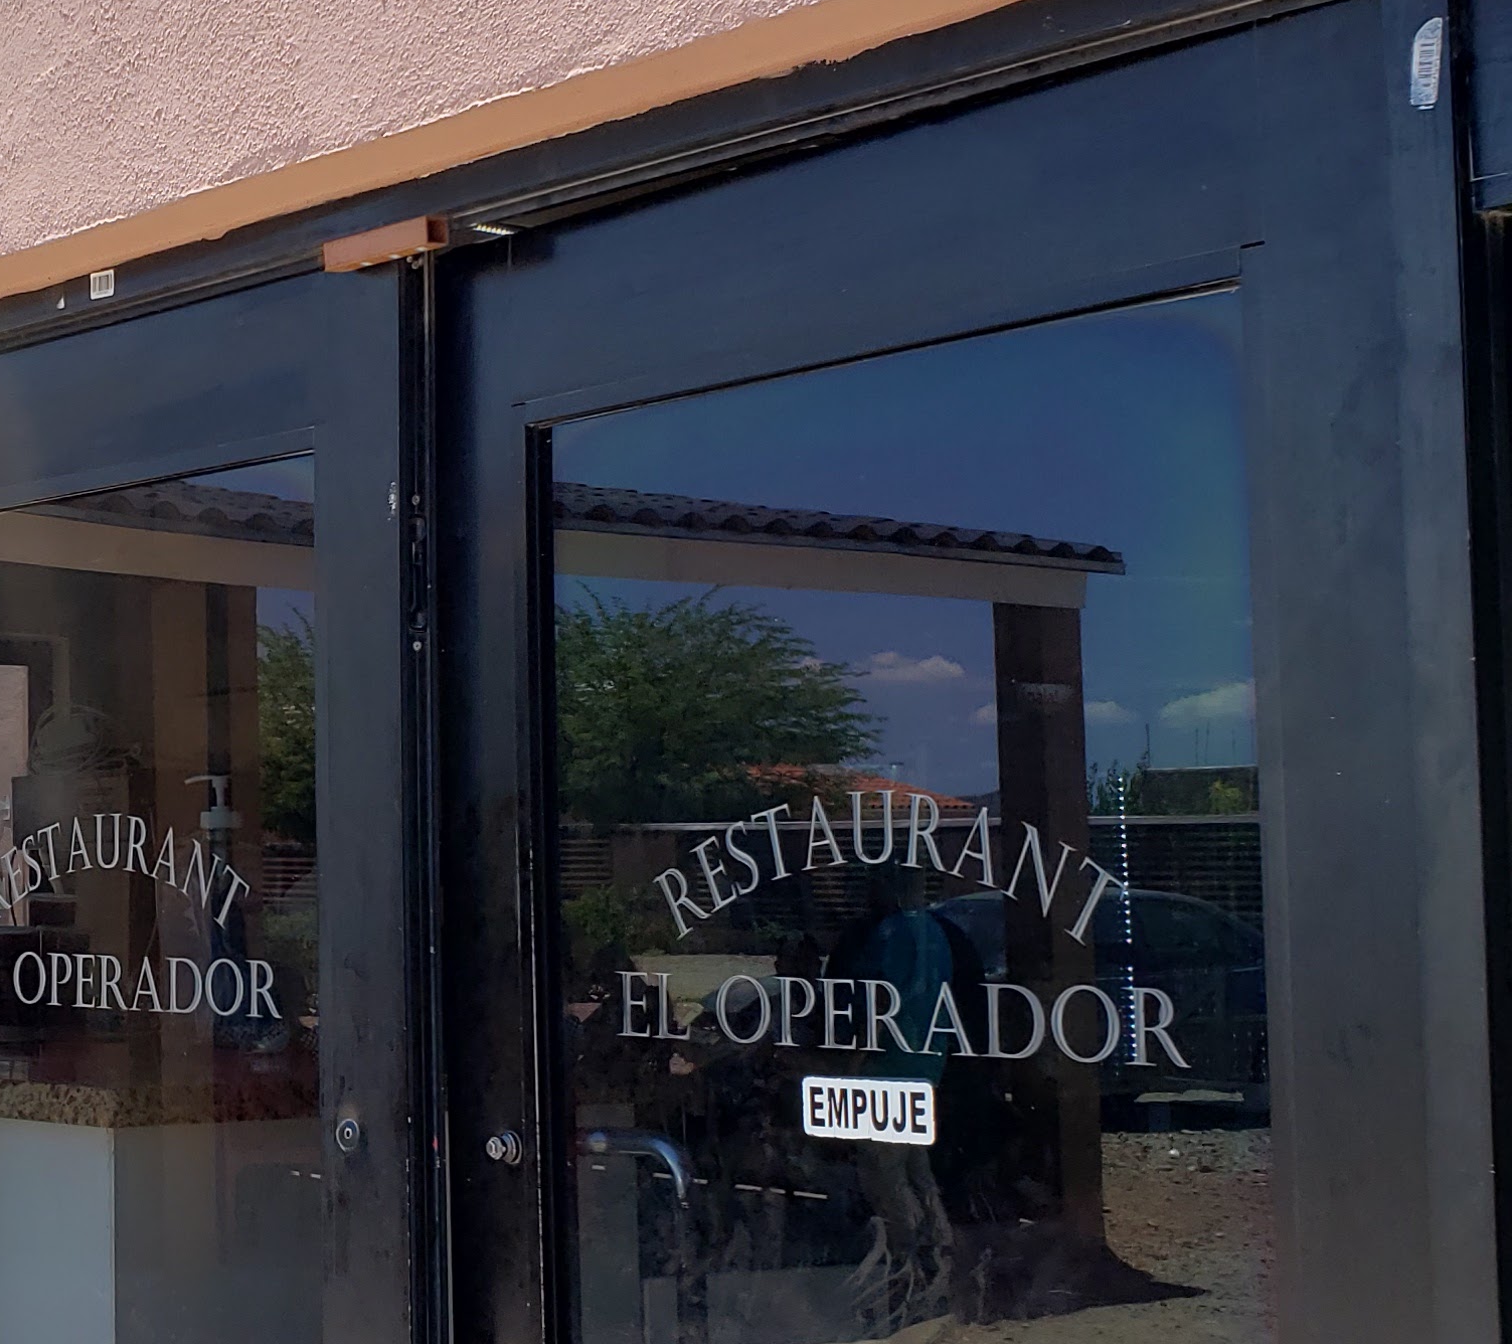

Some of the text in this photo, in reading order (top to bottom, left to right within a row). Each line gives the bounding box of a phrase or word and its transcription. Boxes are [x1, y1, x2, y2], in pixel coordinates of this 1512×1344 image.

[653, 790, 1131, 946] RESTAURANT
[13, 951, 282, 1019] OPERADOR
[616, 970, 1191, 1069] EL OPERADOR
[809, 1085, 928, 1135] EMPUJE
